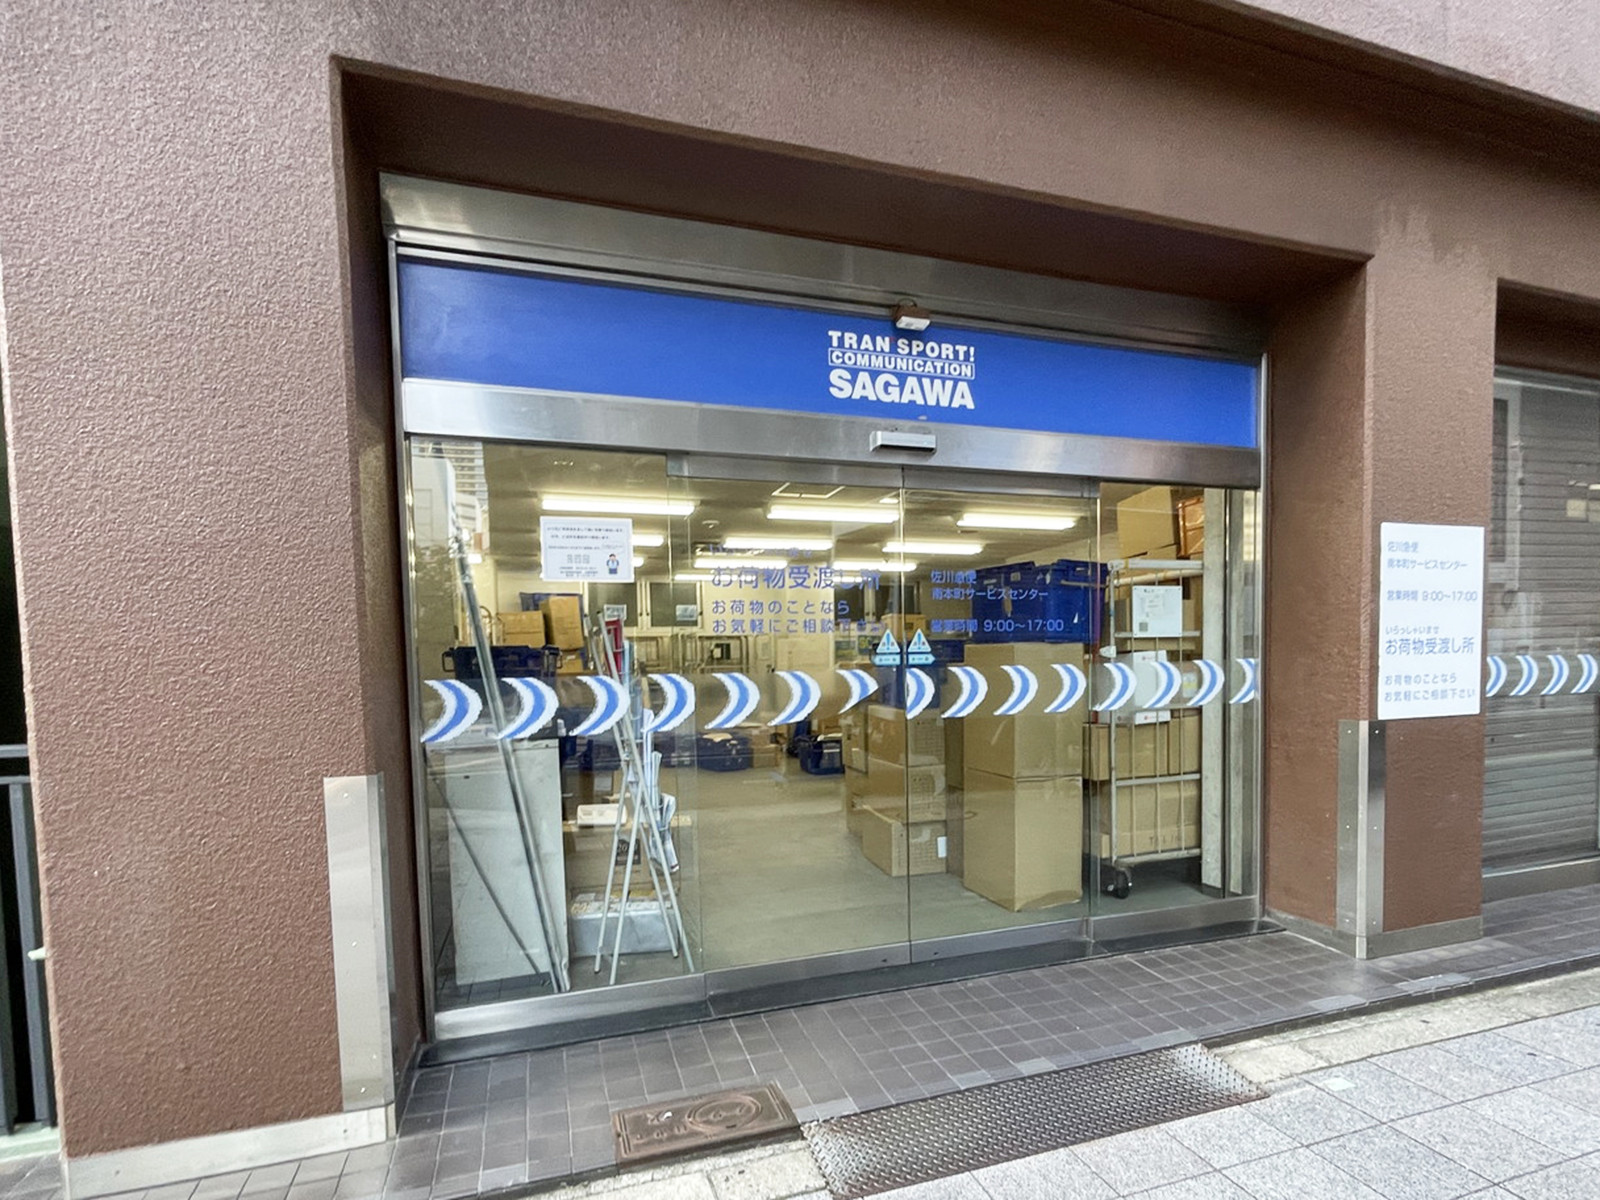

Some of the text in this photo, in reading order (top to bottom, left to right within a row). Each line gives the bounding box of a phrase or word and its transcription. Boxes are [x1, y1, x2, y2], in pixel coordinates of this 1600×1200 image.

[831, 350, 972, 377] COMMUNICATION
[829, 368, 975, 409] SAGAWA
[712, 600, 850, 615] お荷物のことなら
[1385, 637, 1475, 656] お荷物受渡し所
[1384, 673, 1457, 686] お荷物のことなら
